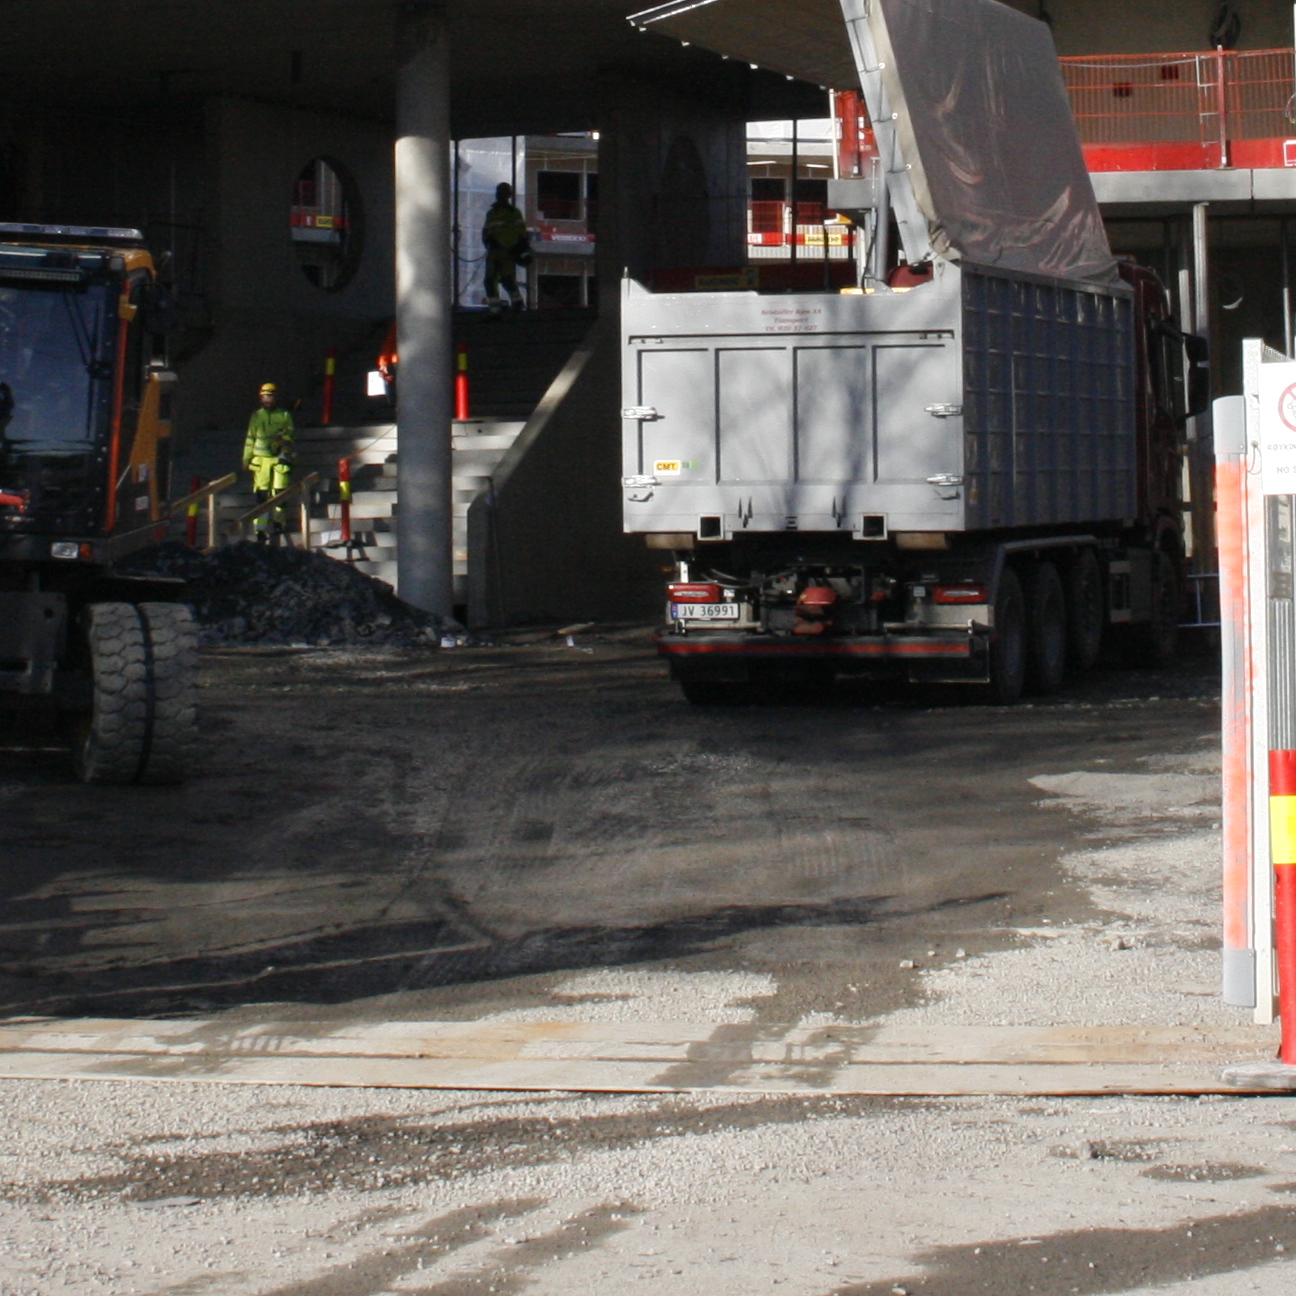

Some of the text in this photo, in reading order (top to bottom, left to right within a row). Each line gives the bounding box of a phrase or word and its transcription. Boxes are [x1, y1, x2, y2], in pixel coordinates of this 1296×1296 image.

[656, 462, 675, 471] CMT
[1276, 466, 1290, 474] NO
[682, 605, 735, 617] JV 36991
